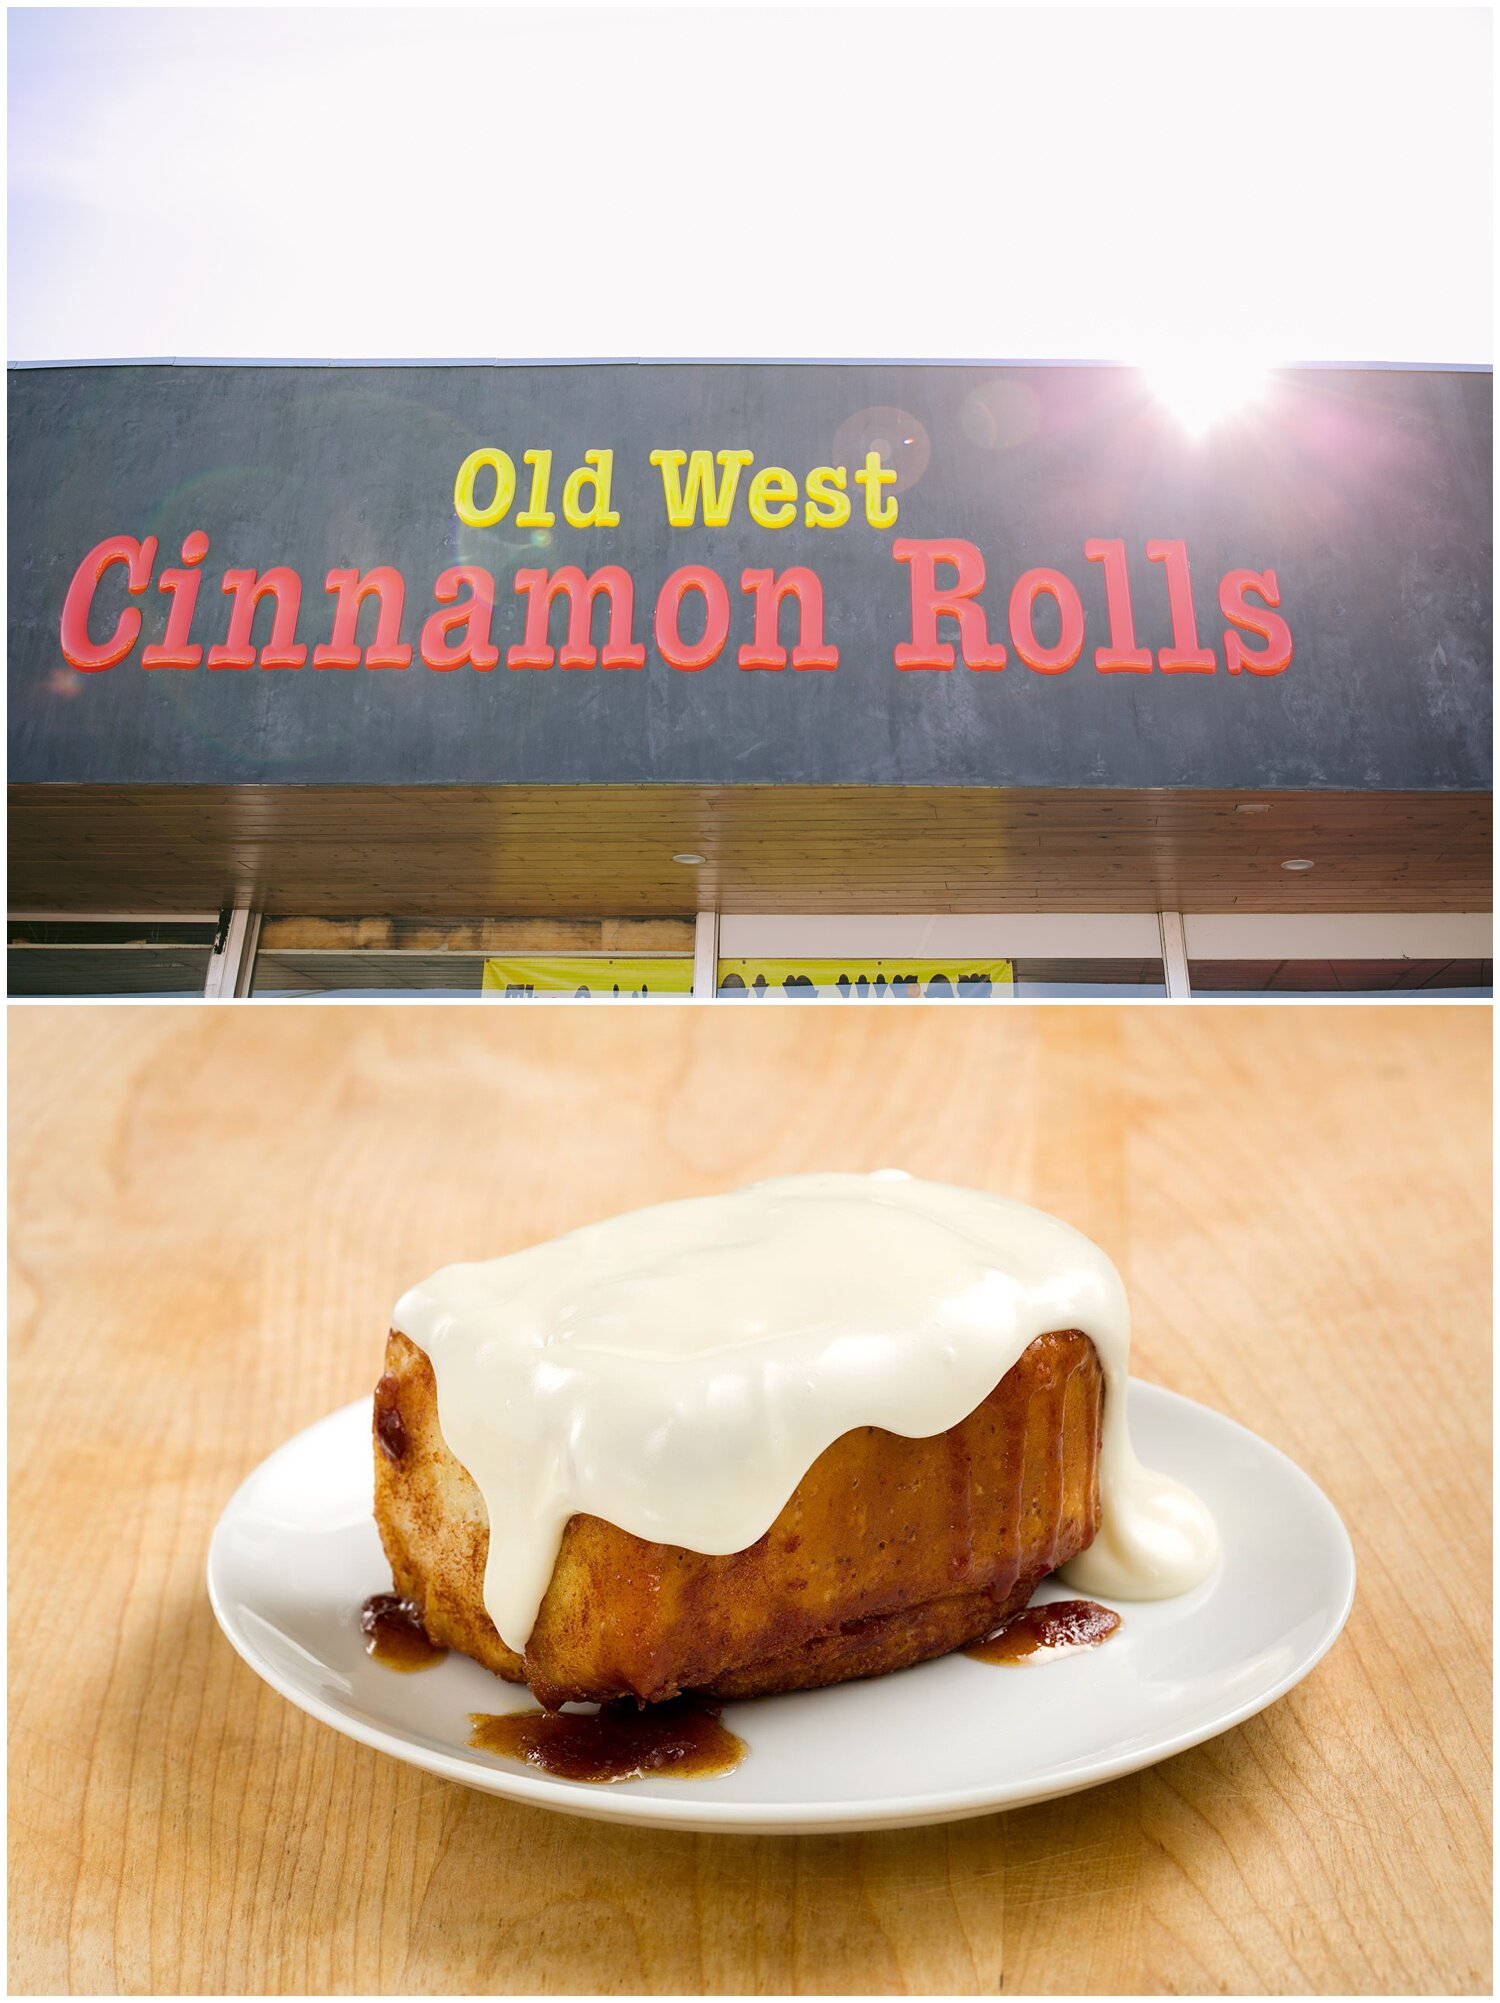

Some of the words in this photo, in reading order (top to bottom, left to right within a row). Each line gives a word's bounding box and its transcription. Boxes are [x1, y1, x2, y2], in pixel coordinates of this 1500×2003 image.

[454, 447, 620, 528] Old
[650, 449, 899, 529] West
[60, 531, 839, 673] Cinnamon
[893, 538, 1294, 676] Rolls
